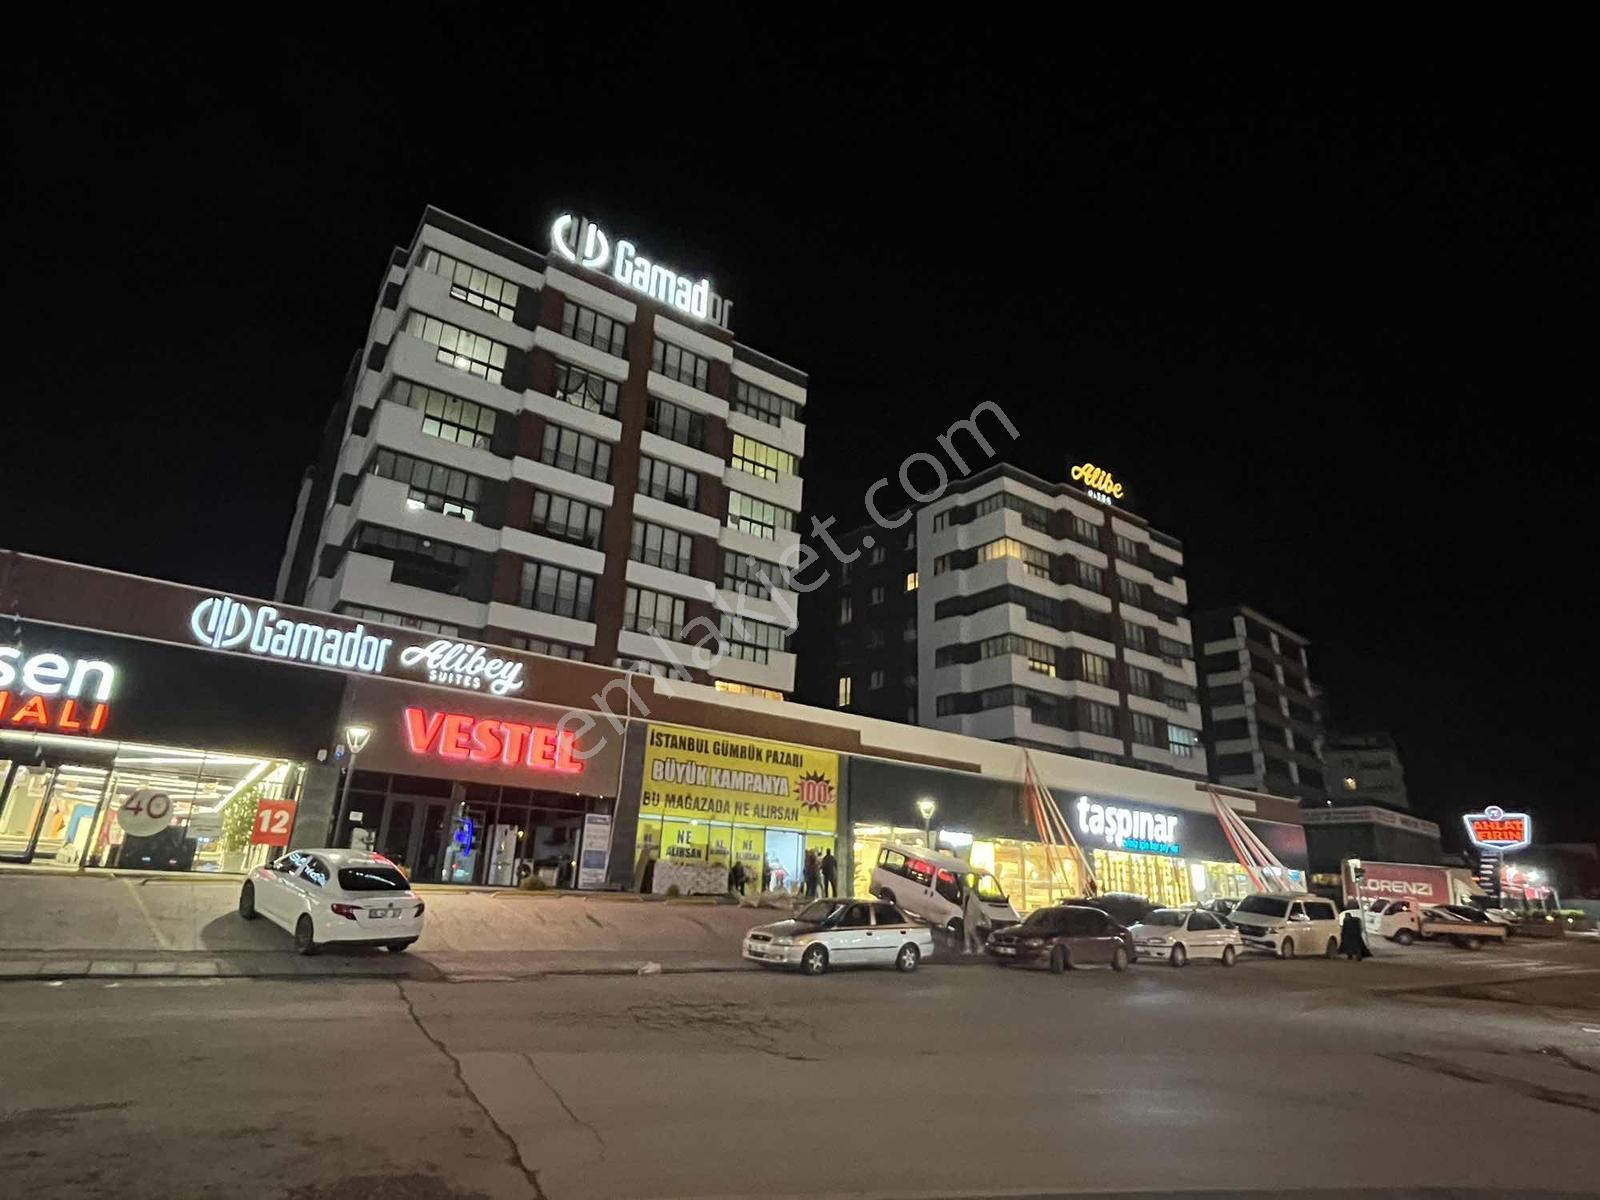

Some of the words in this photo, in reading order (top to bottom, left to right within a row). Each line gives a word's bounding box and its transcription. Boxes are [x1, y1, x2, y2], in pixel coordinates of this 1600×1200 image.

[613, 239, 734, 329] Gamador
[249, 605, 392, 673] Gamador
[400, 639, 524, 695] Alibey
[429, 669, 481, 690] SUITES
[0, 690, 109, 733] ALI
[405, 706, 585, 774] VESTEL
[649, 728, 710, 755] İSTANBUL
[713, 740, 763, 762] GÜMRÜK
[765, 749, 804, 768] PAZARI
[651, 757, 708, 788] BÜYÜK
[710, 766, 790, 798] KAMPANYA
[123, 791, 170, 820] 40
[258, 808, 288, 835] 12
[663, 792, 731, 815] MAĞAZADA
[734, 803, 750, 817] NE
[753, 804, 800, 822] ALIRSAN
[677, 829, 692, 844] NE
